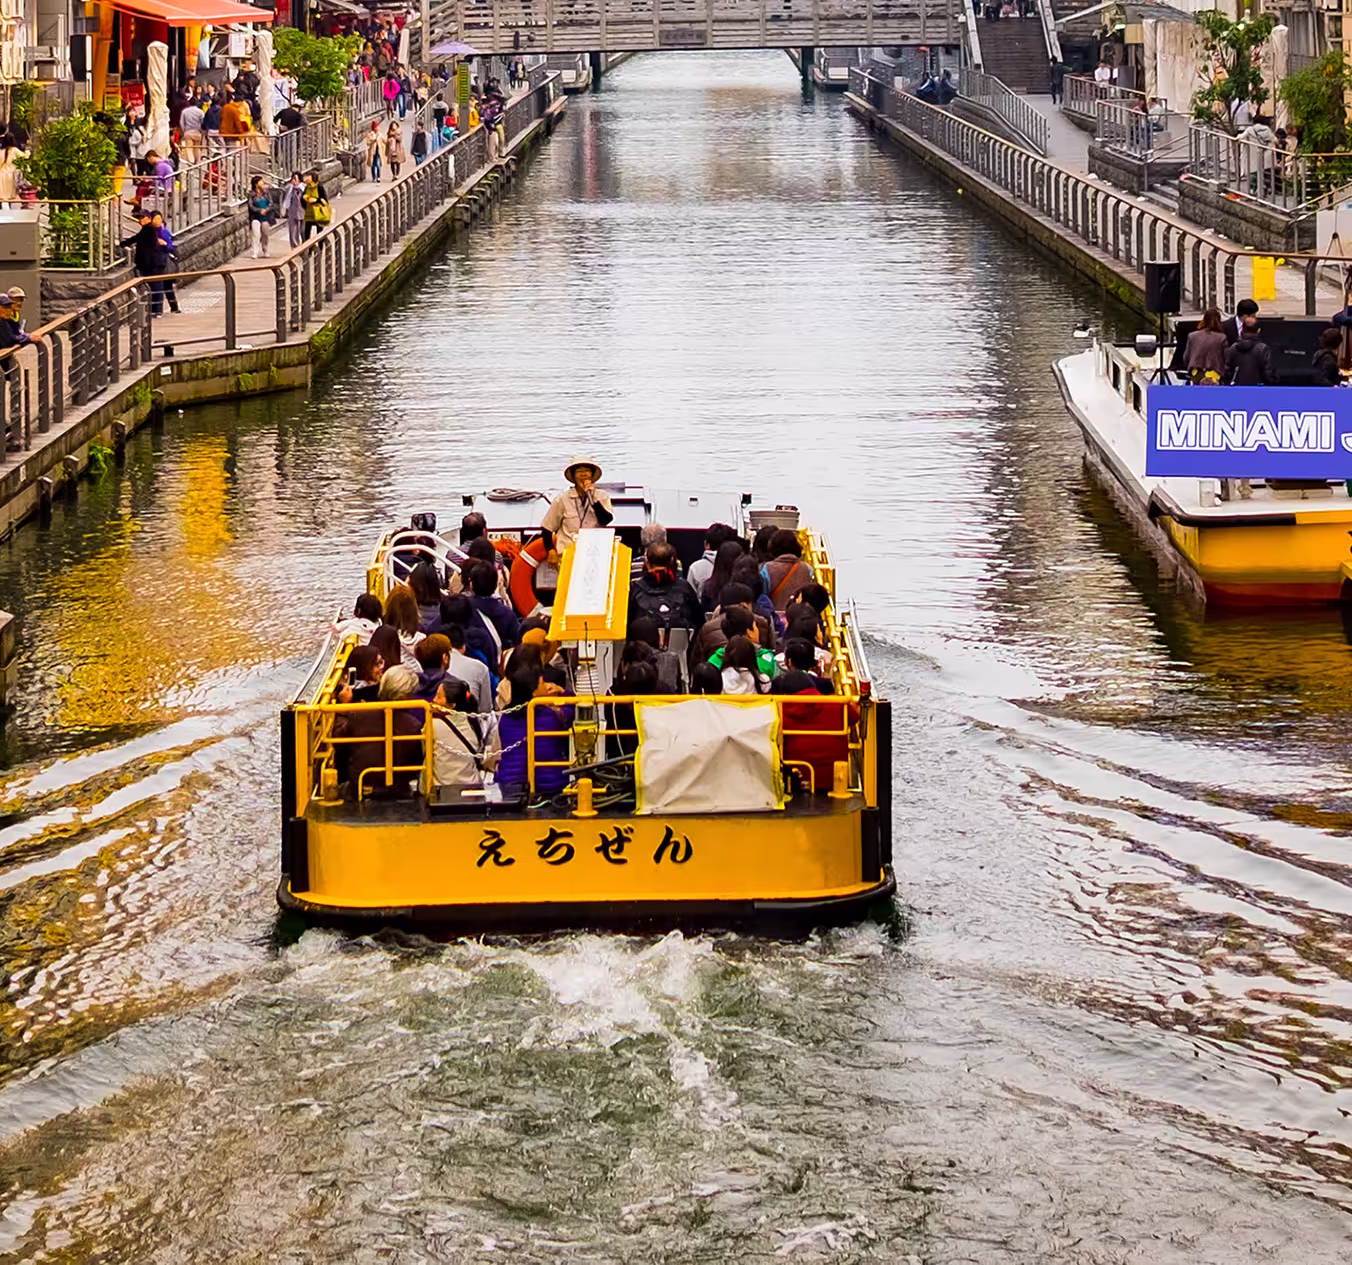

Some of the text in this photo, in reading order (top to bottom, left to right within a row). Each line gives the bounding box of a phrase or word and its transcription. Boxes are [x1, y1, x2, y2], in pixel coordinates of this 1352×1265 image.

[1157, 410, 1335, 453] MINAMI
[475, 823, 694, 868] えちぜん
